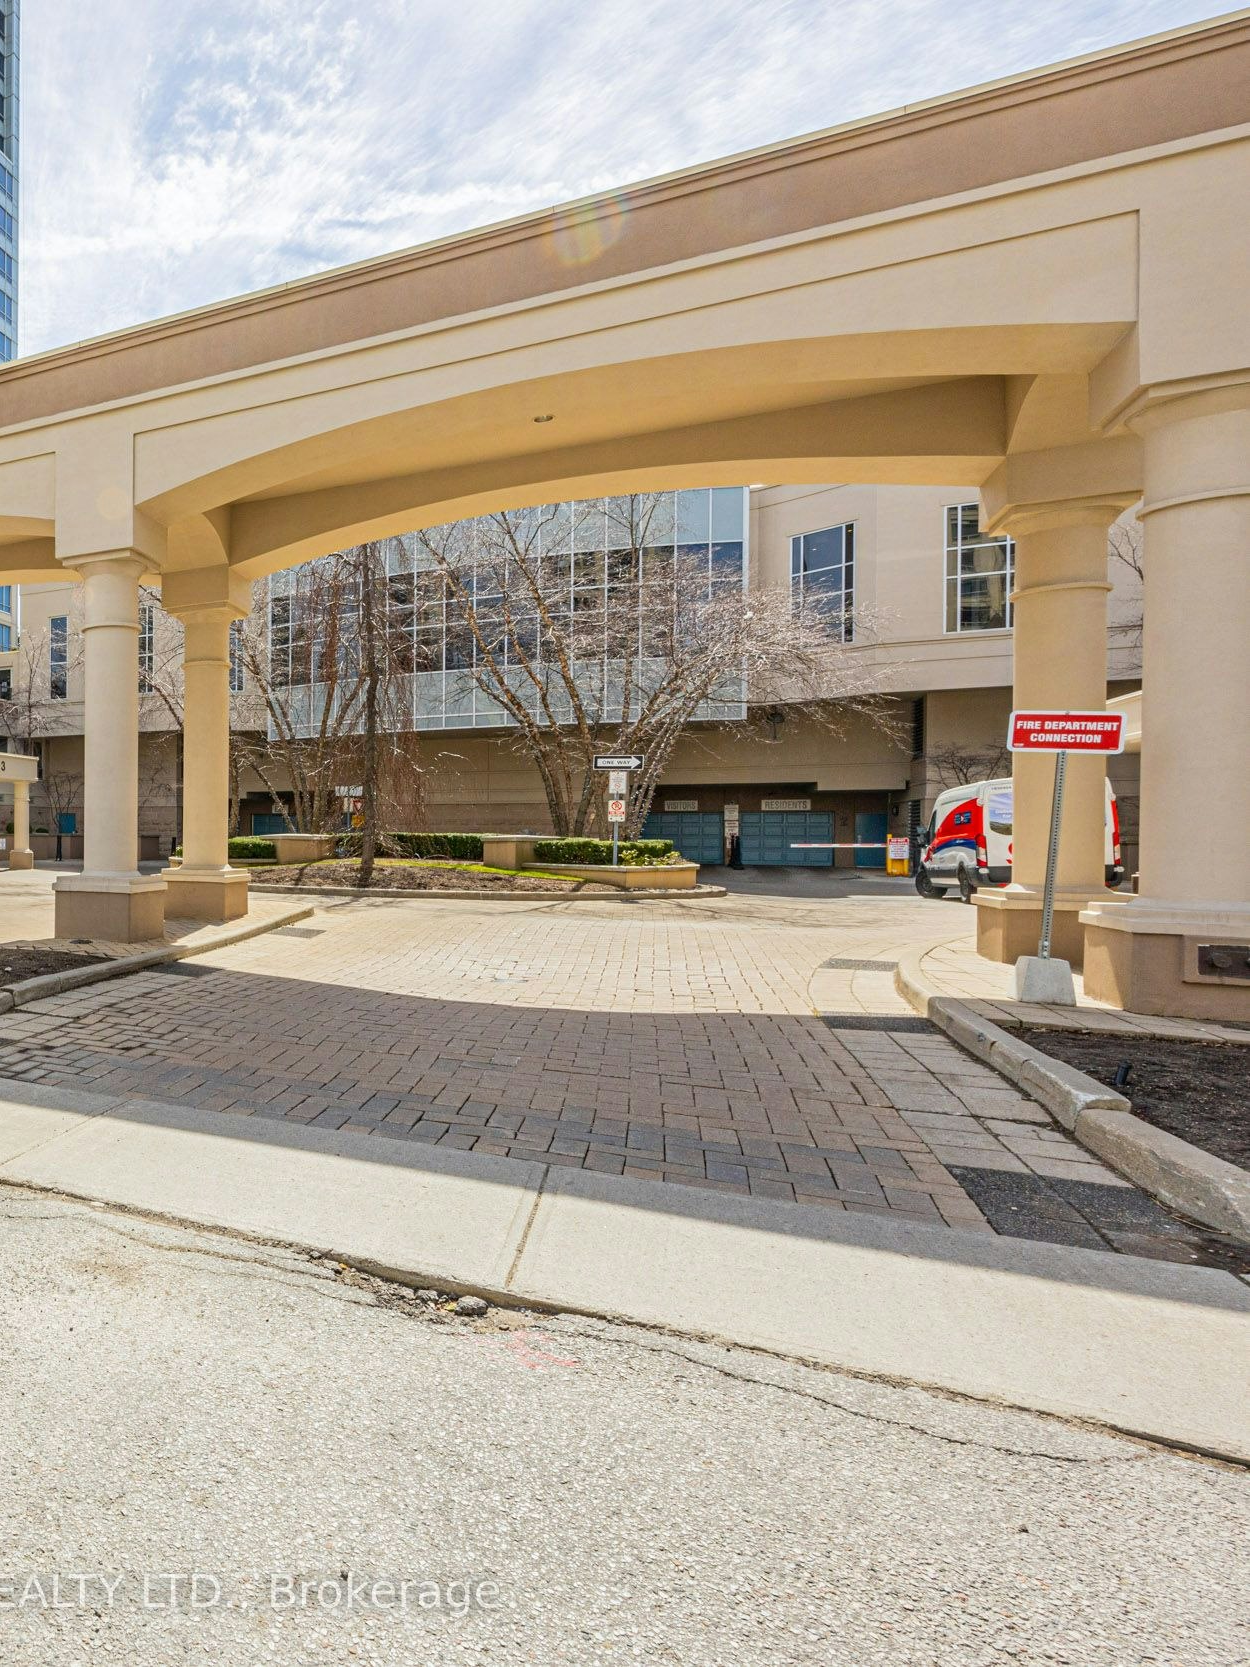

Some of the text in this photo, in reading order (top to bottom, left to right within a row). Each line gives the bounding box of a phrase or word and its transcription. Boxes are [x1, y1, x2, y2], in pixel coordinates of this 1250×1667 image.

[1016, 720, 1119, 731] FIRE DEPARTMENT
[1030, 733, 1102, 743] CONNECTION
[0, 761, 6, 771] 3
[666, 801, 696, 810] VISITORS
[765, 800, 807, 809] RESIDENTS
